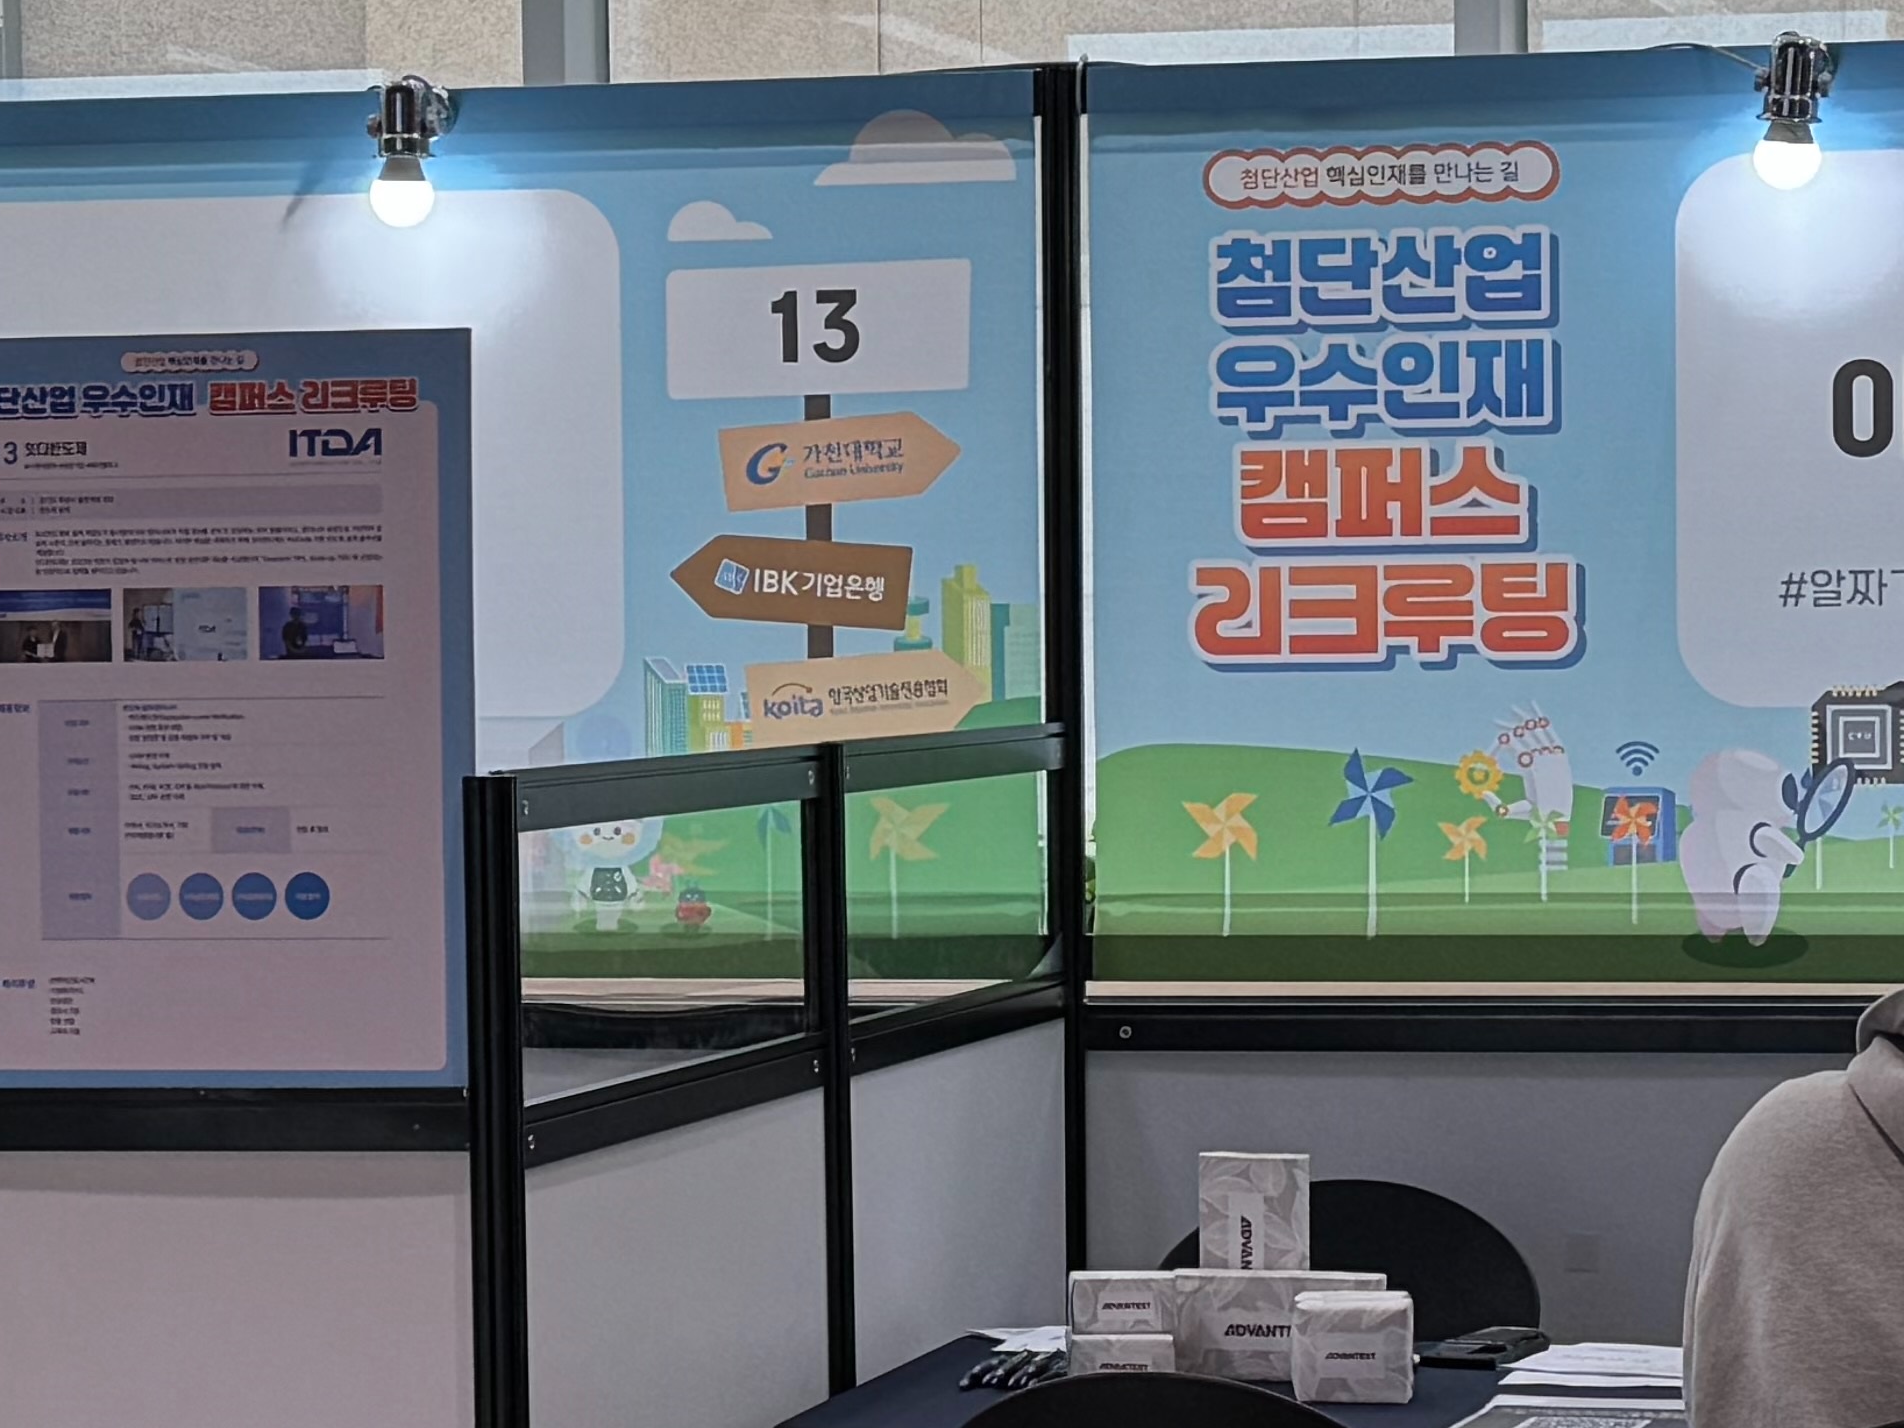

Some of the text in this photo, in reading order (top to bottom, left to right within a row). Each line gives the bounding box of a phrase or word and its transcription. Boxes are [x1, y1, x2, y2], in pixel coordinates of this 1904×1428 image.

[1241, 161, 1519, 190] 첨단산업 핵심인재를 만나는 길
[1215, 231, 1543, 318] 첨단산업
[770, 288, 860, 364] 13
[81, 383, 194, 412] 우수인재
[210, 380, 296, 412] 캠퍼스
[300, 377, 418, 411] 리크루팅
[1216, 338, 1545, 423] 우수인재
[289, 428, 382, 457] ITDA
[1240, 447, 1521, 539] 캠퍼스
[1195, 562, 1569, 656] 리크루팅
[1225, 1324, 1292, 1338] ADVANT
